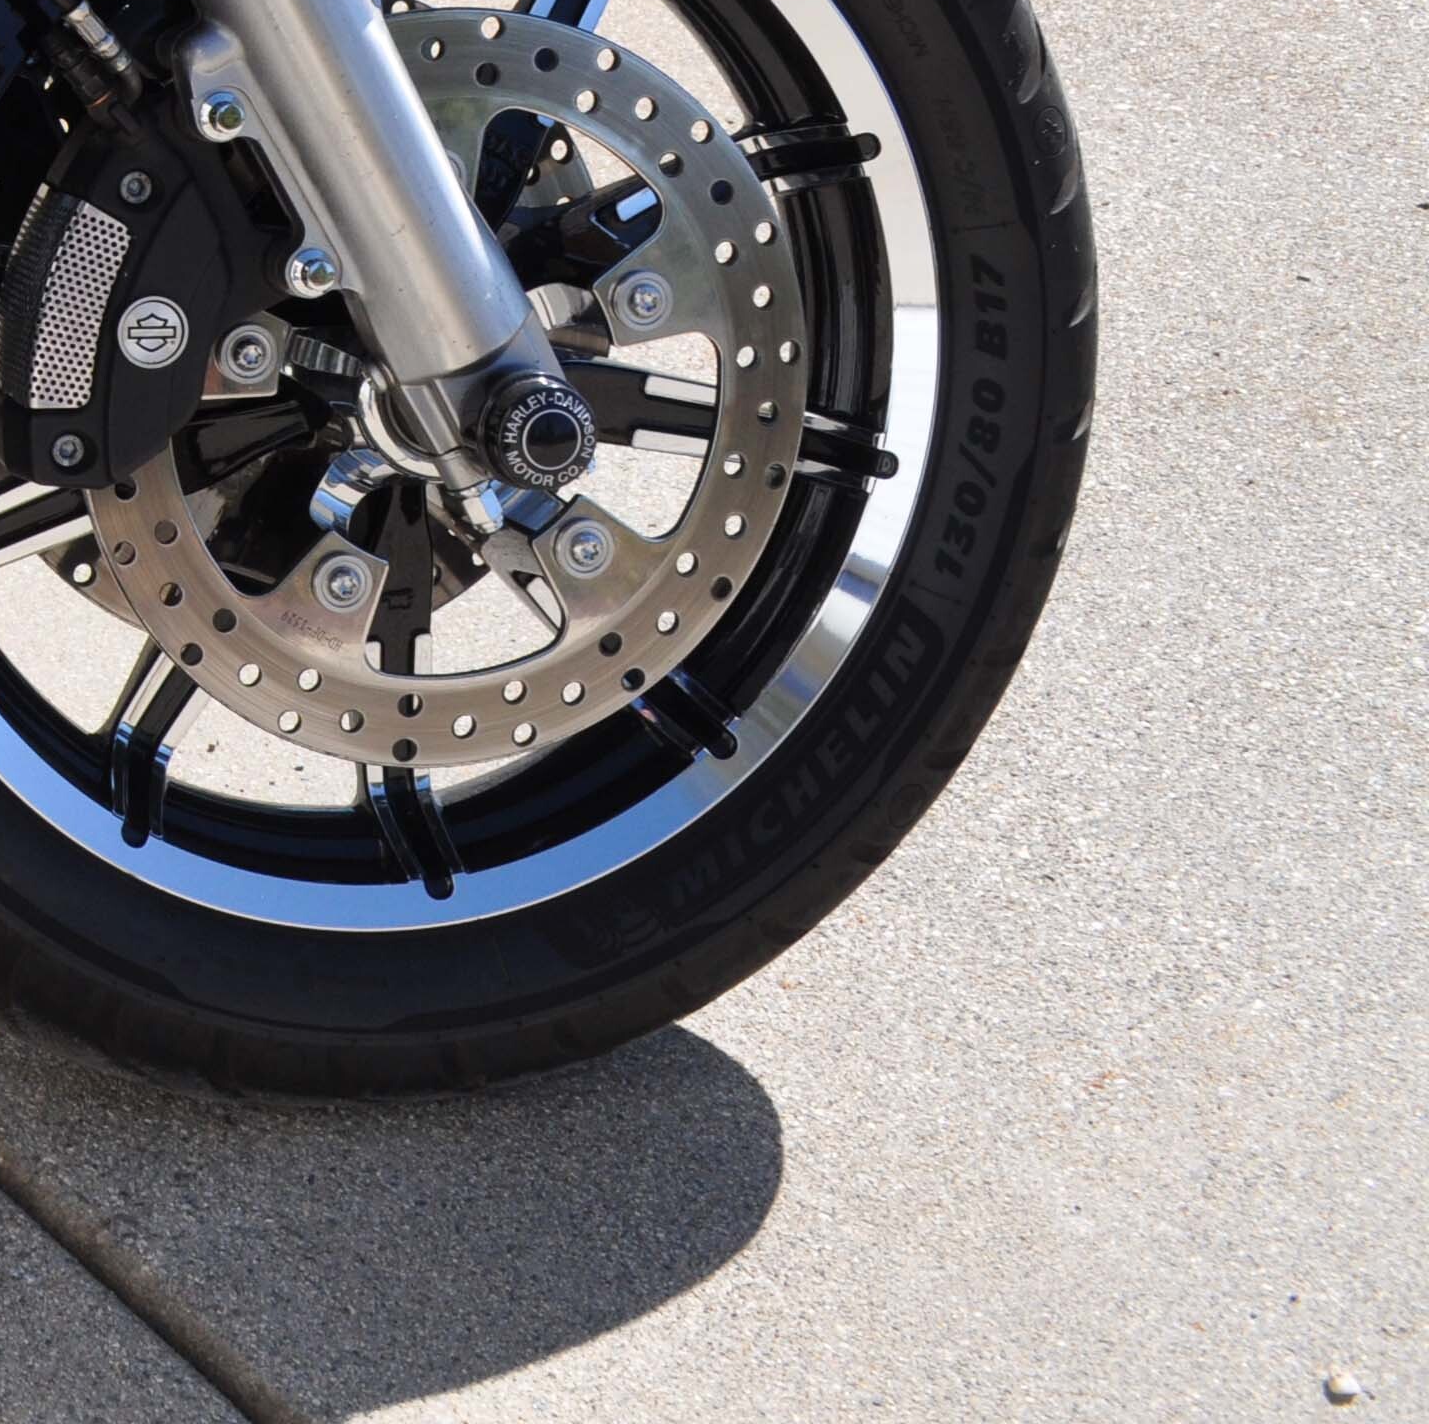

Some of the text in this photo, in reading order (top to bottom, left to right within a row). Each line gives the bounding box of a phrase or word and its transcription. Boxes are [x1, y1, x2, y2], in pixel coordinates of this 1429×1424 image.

[970, 253, 1009, 363] B17
[502, 391, 596, 459] HARLEY-DAVIDSON
[505, 450, 554, 487] MOTOR
[933, 378, 1008, 580] 130/80
[669, 614, 930, 908] MICHELIN
